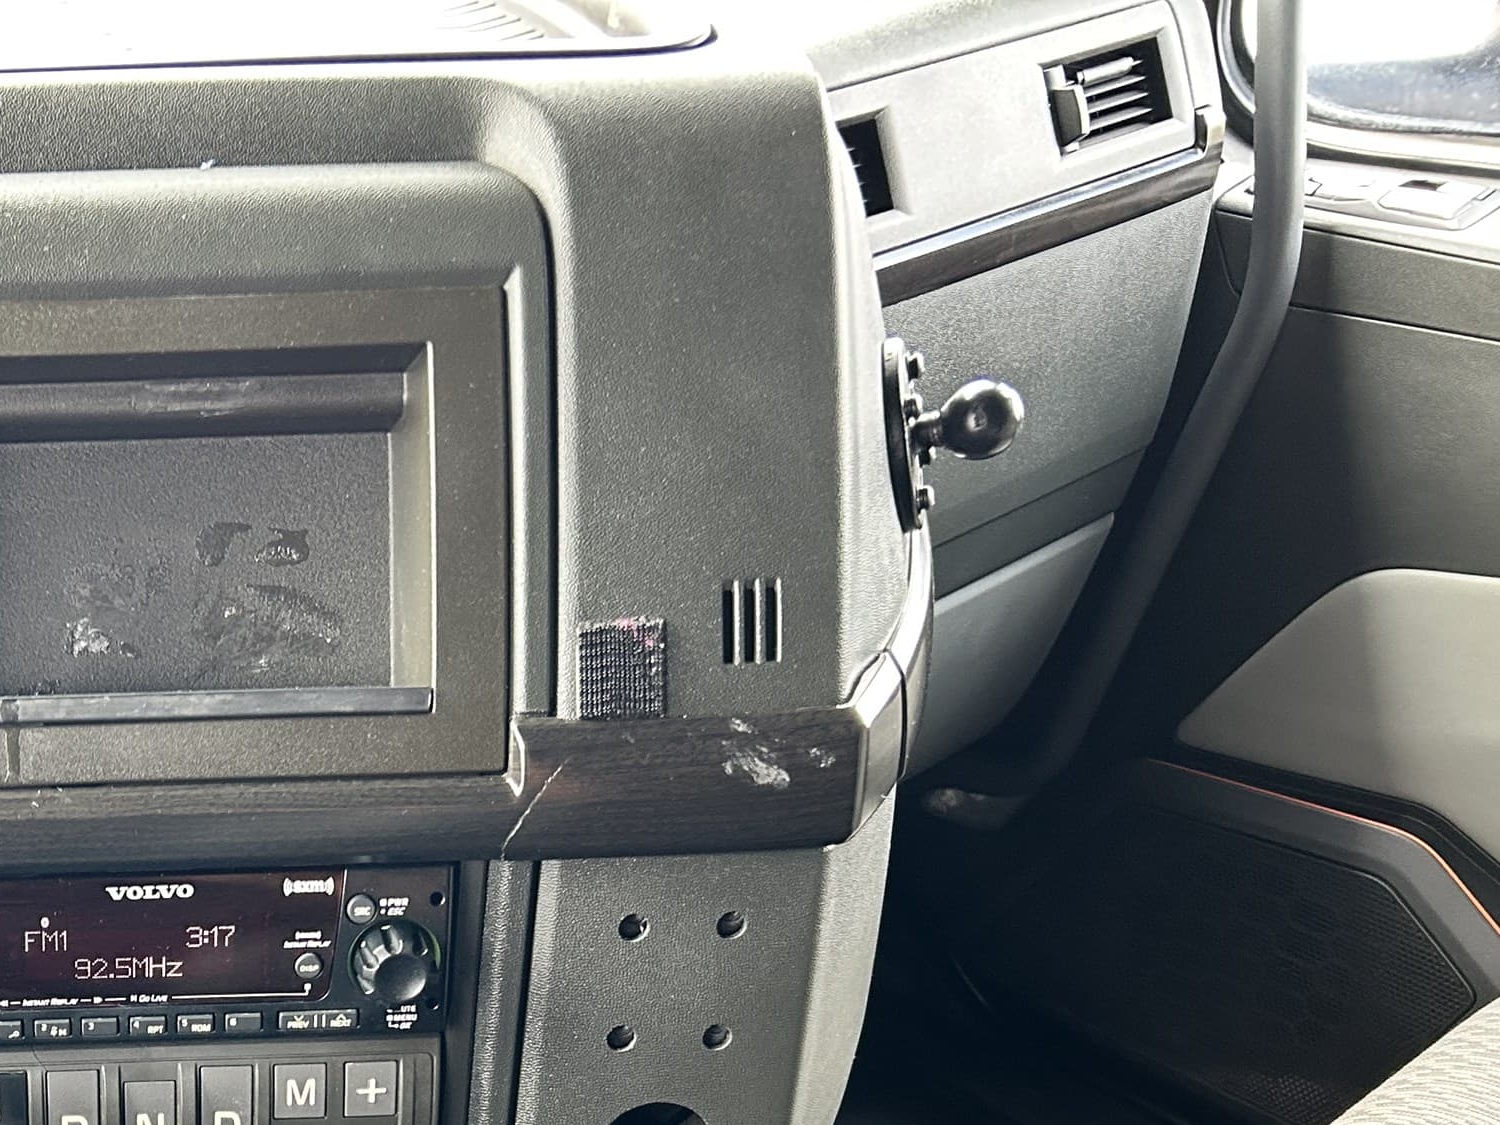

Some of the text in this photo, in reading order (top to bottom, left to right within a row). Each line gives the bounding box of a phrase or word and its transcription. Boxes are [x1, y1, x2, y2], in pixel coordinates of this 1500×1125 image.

[105, 884, 194, 901] VOLVO
[24, 930, 68, 952] FM1
[186, 925, 236, 948] 3:17
[74, 956, 183, 979] 92.5MHz
[88, 1023, 94, 1031] 3
[133, 1020, 140, 1029] 4
[286, 1078, 316, 1106] M
